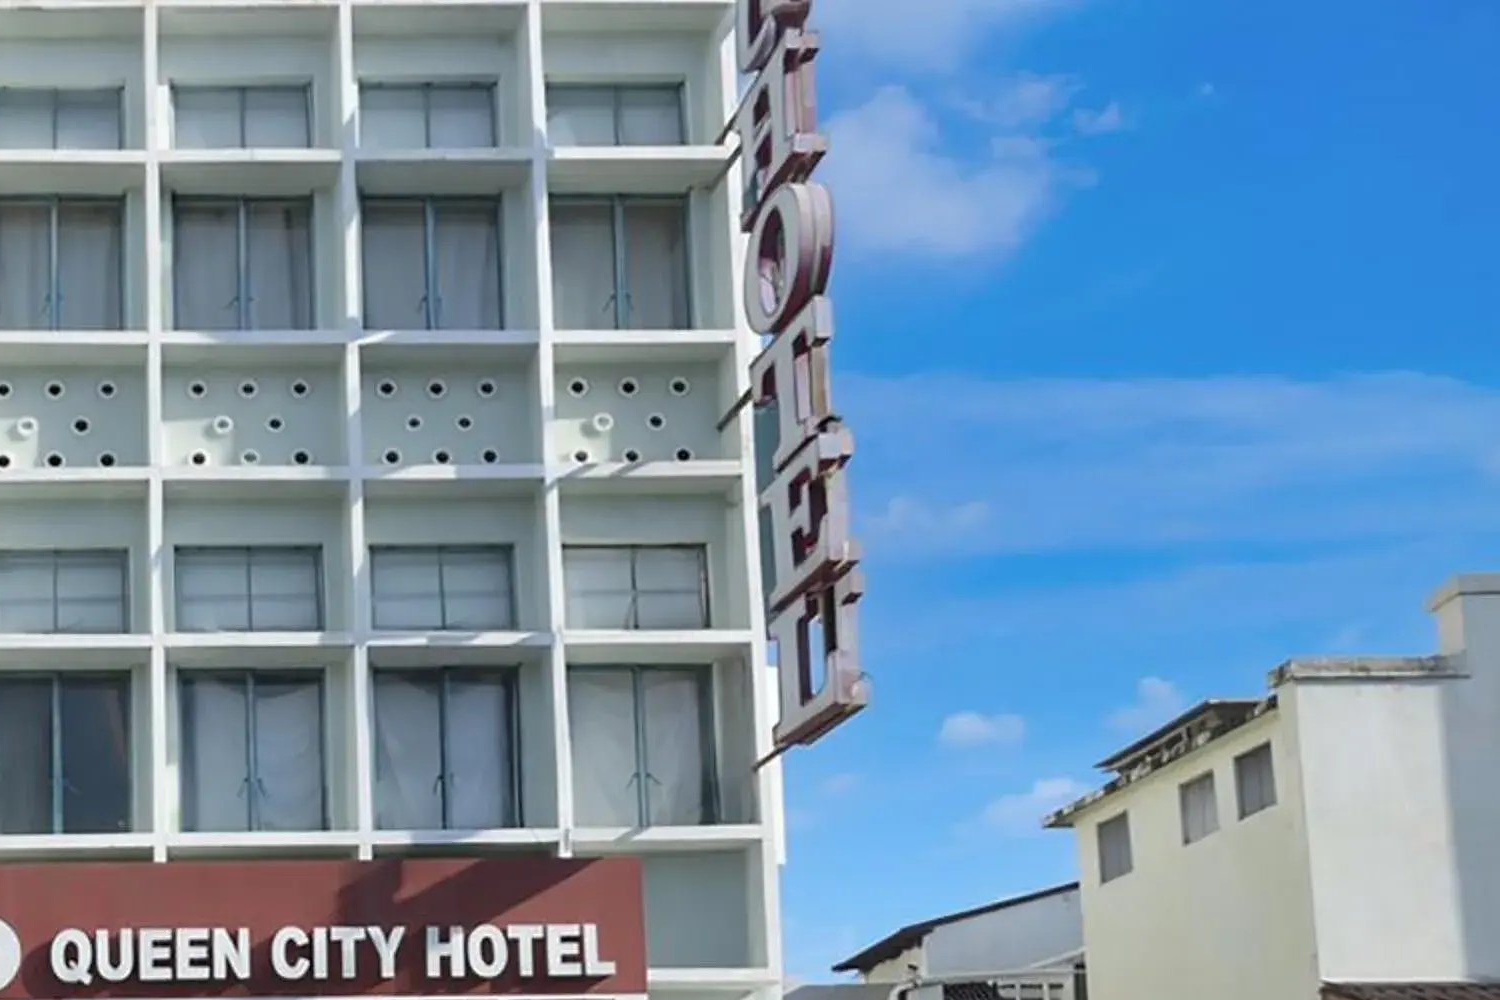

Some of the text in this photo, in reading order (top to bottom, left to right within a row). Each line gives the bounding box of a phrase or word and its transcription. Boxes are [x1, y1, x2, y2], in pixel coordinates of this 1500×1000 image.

[738, 28, 869, 746] HOTEL
[49, 926, 250, 985] QUEEN
[271, 926, 405, 981] CITY
[426, 923, 616, 979] HOTEL
